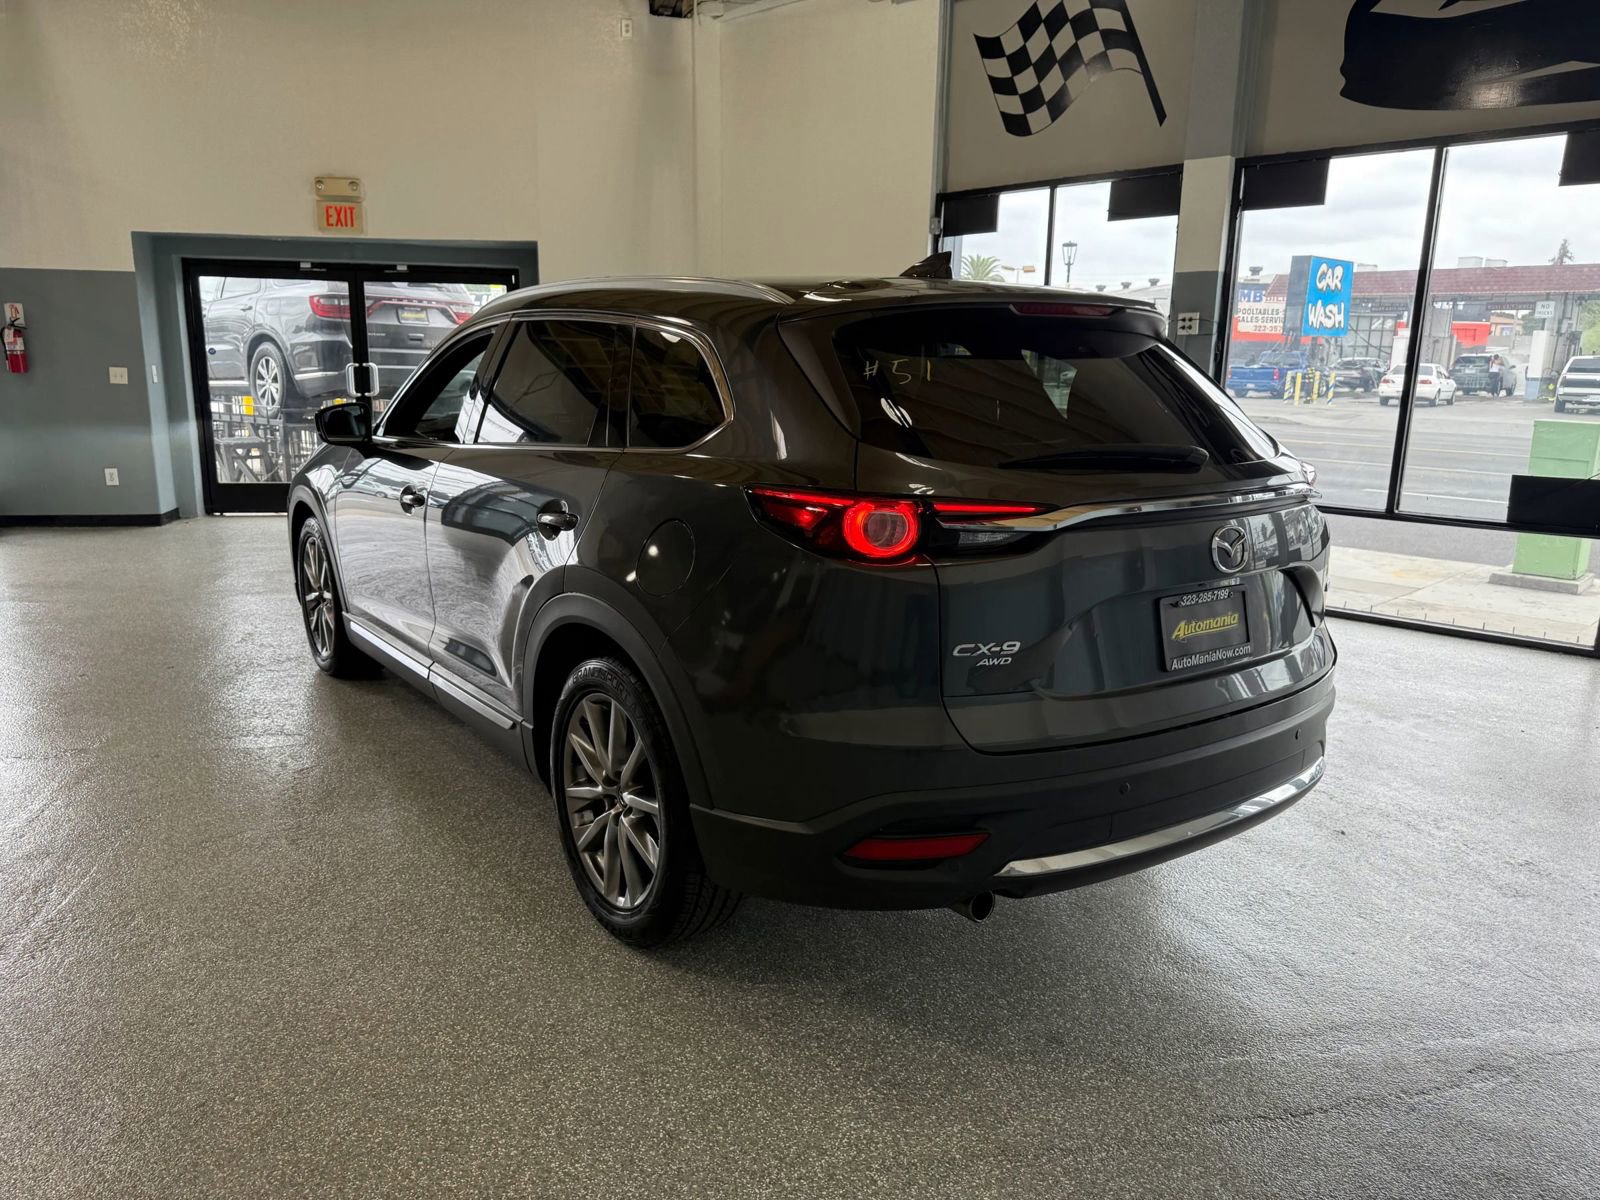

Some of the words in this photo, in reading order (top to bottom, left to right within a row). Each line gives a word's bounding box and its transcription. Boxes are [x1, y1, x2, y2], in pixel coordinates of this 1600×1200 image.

[325, 205, 355, 227] EXIT
[1316, 263, 1343, 291] CAR
[1308, 299, 1344, 329] WASH
[1172, 612, 1239, 640] Automania
[952, 641, 1021, 656] CX-9
[976, 657, 1012, 666] AWD
[1171, 645, 1251, 671] AutoManiaNow.com
